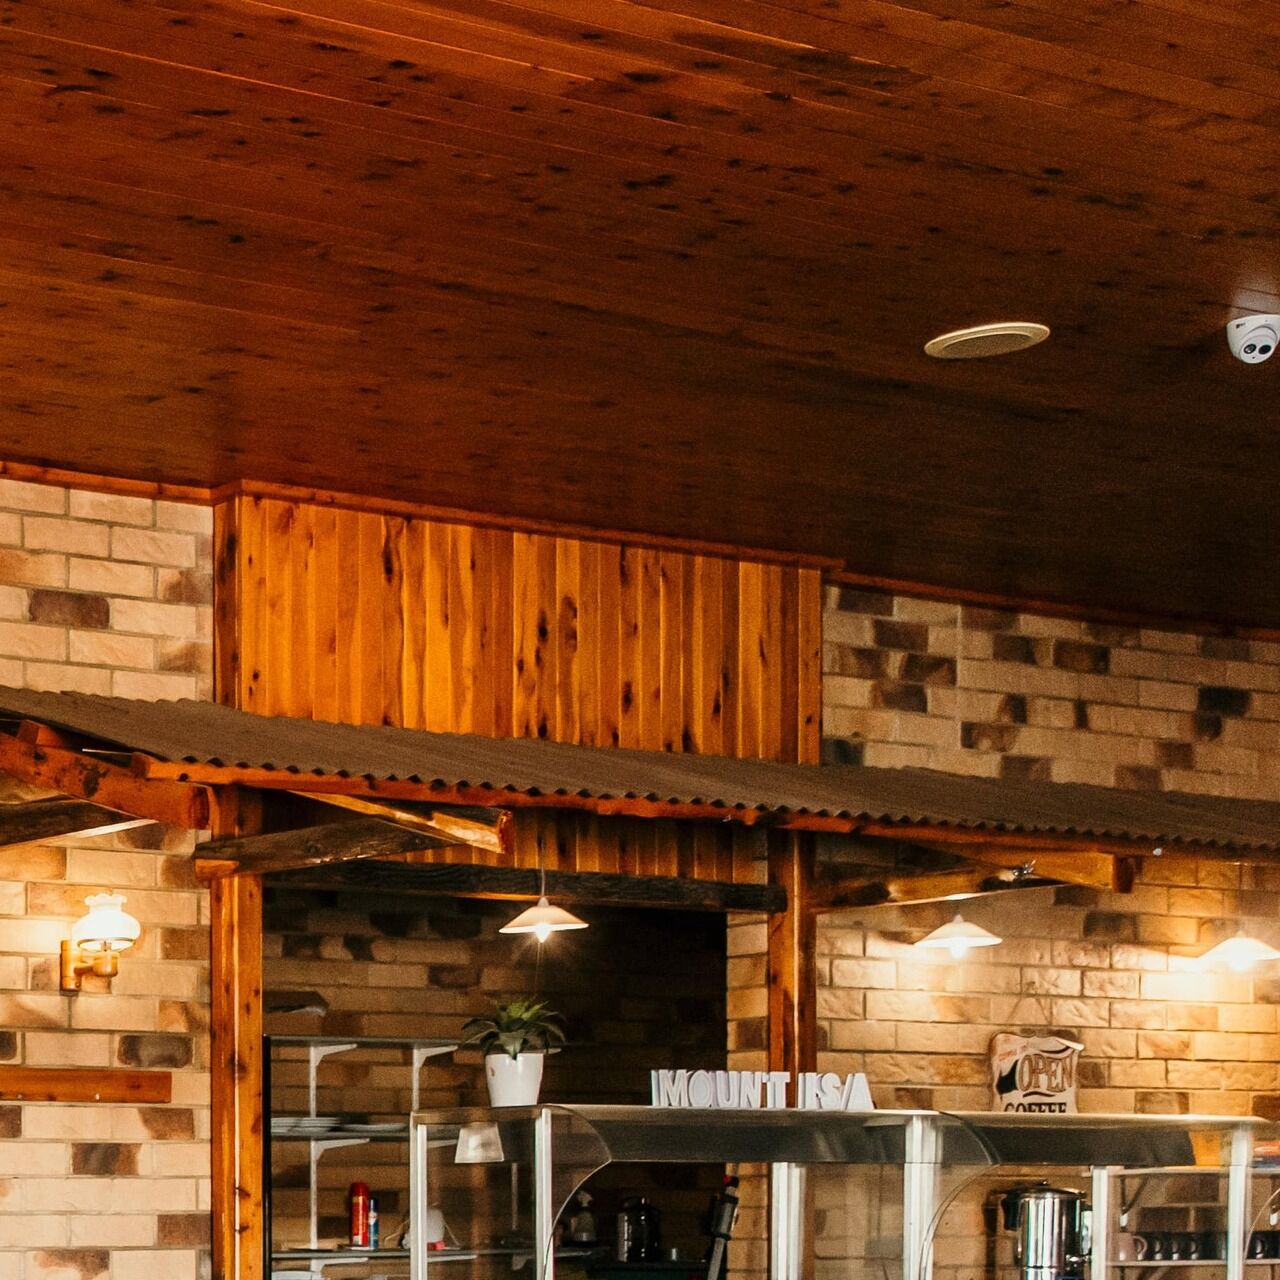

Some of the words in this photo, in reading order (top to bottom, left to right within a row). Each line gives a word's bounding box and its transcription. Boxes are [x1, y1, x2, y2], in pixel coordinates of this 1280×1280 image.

[651, 1069, 790, 1109] MOUNT
[797, 1072, 875, 1110] ISA
[1019, 1053, 1073, 1093] OPEN
